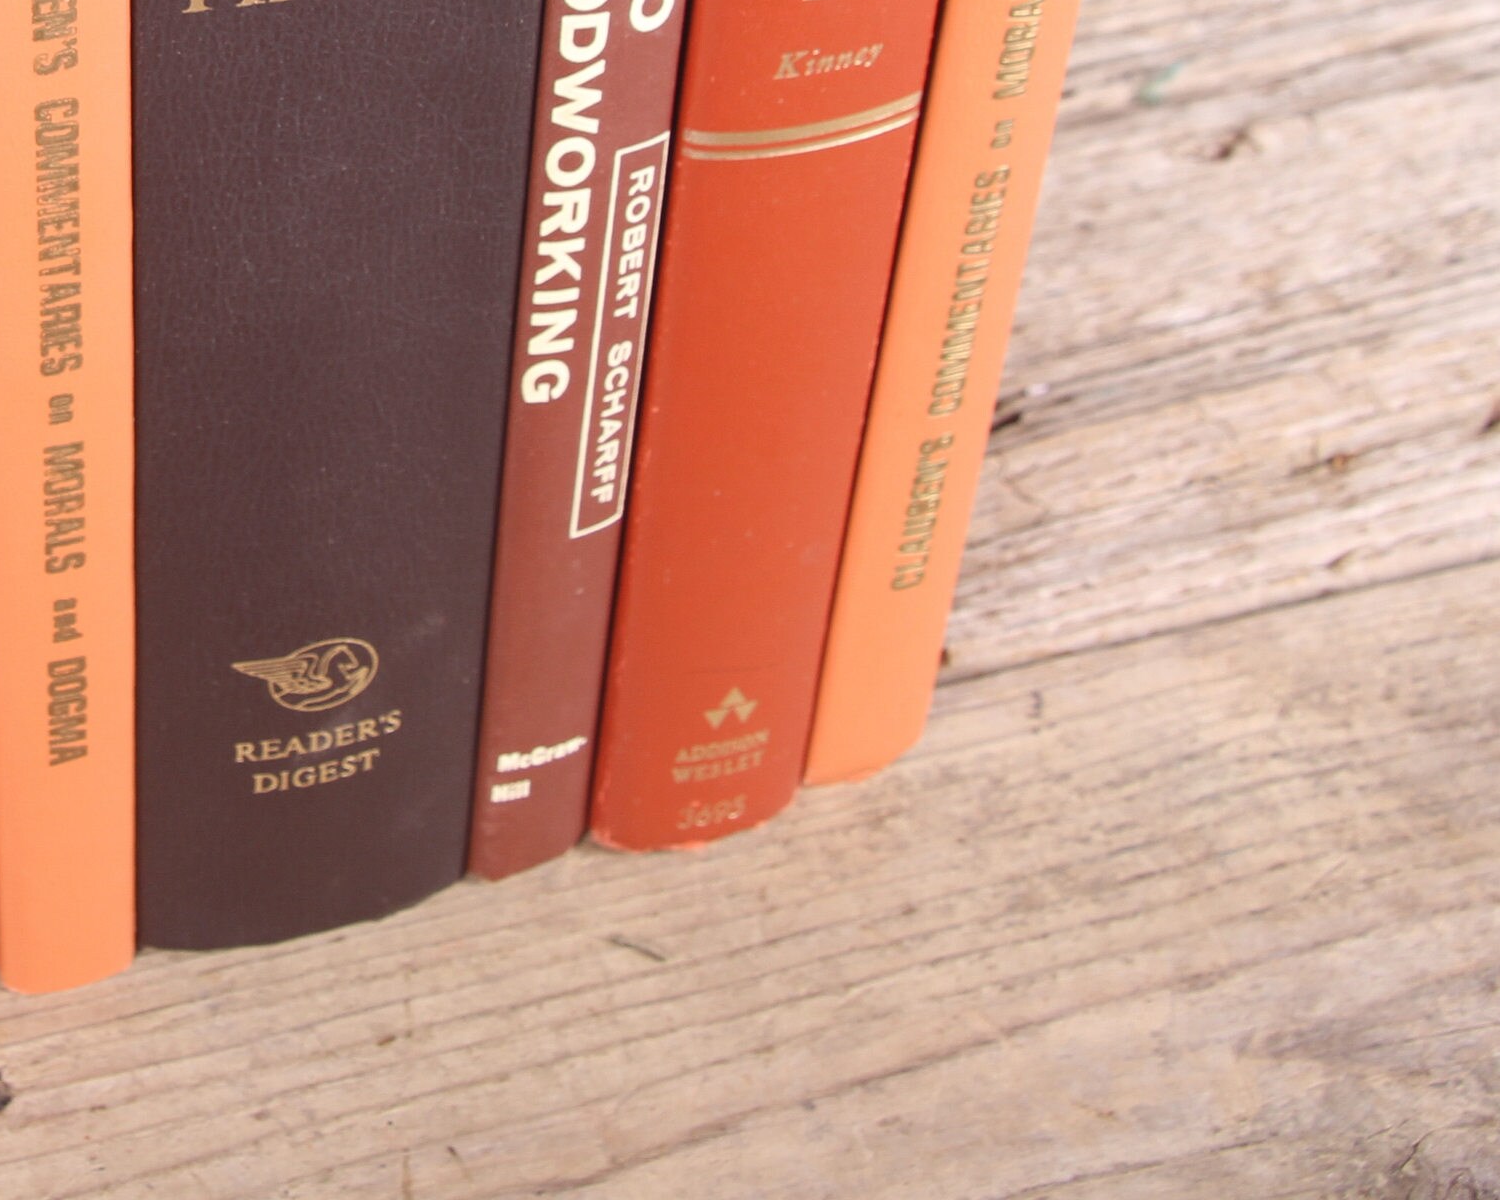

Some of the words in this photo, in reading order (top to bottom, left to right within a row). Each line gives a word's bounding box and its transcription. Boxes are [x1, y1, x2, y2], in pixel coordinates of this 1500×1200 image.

[774, 41, 883, 80] Kinney
[35, 97, 84, 377] COMMENTARIES
[614, 164, 655, 319] ROBERT
[928, 164, 1011, 418] COMMENTARIES
[990, 118, 1015, 149] on
[48, 393, 74, 426] on
[590, 341, 633, 505] SCHARFF
[43, 441, 87, 575] MORALS
[52, 598, 84, 645] and
[47, 655, 89, 767] DOGMA
[235, 709, 402, 763] READER'S
[252, 748, 381, 794] DIGEST
